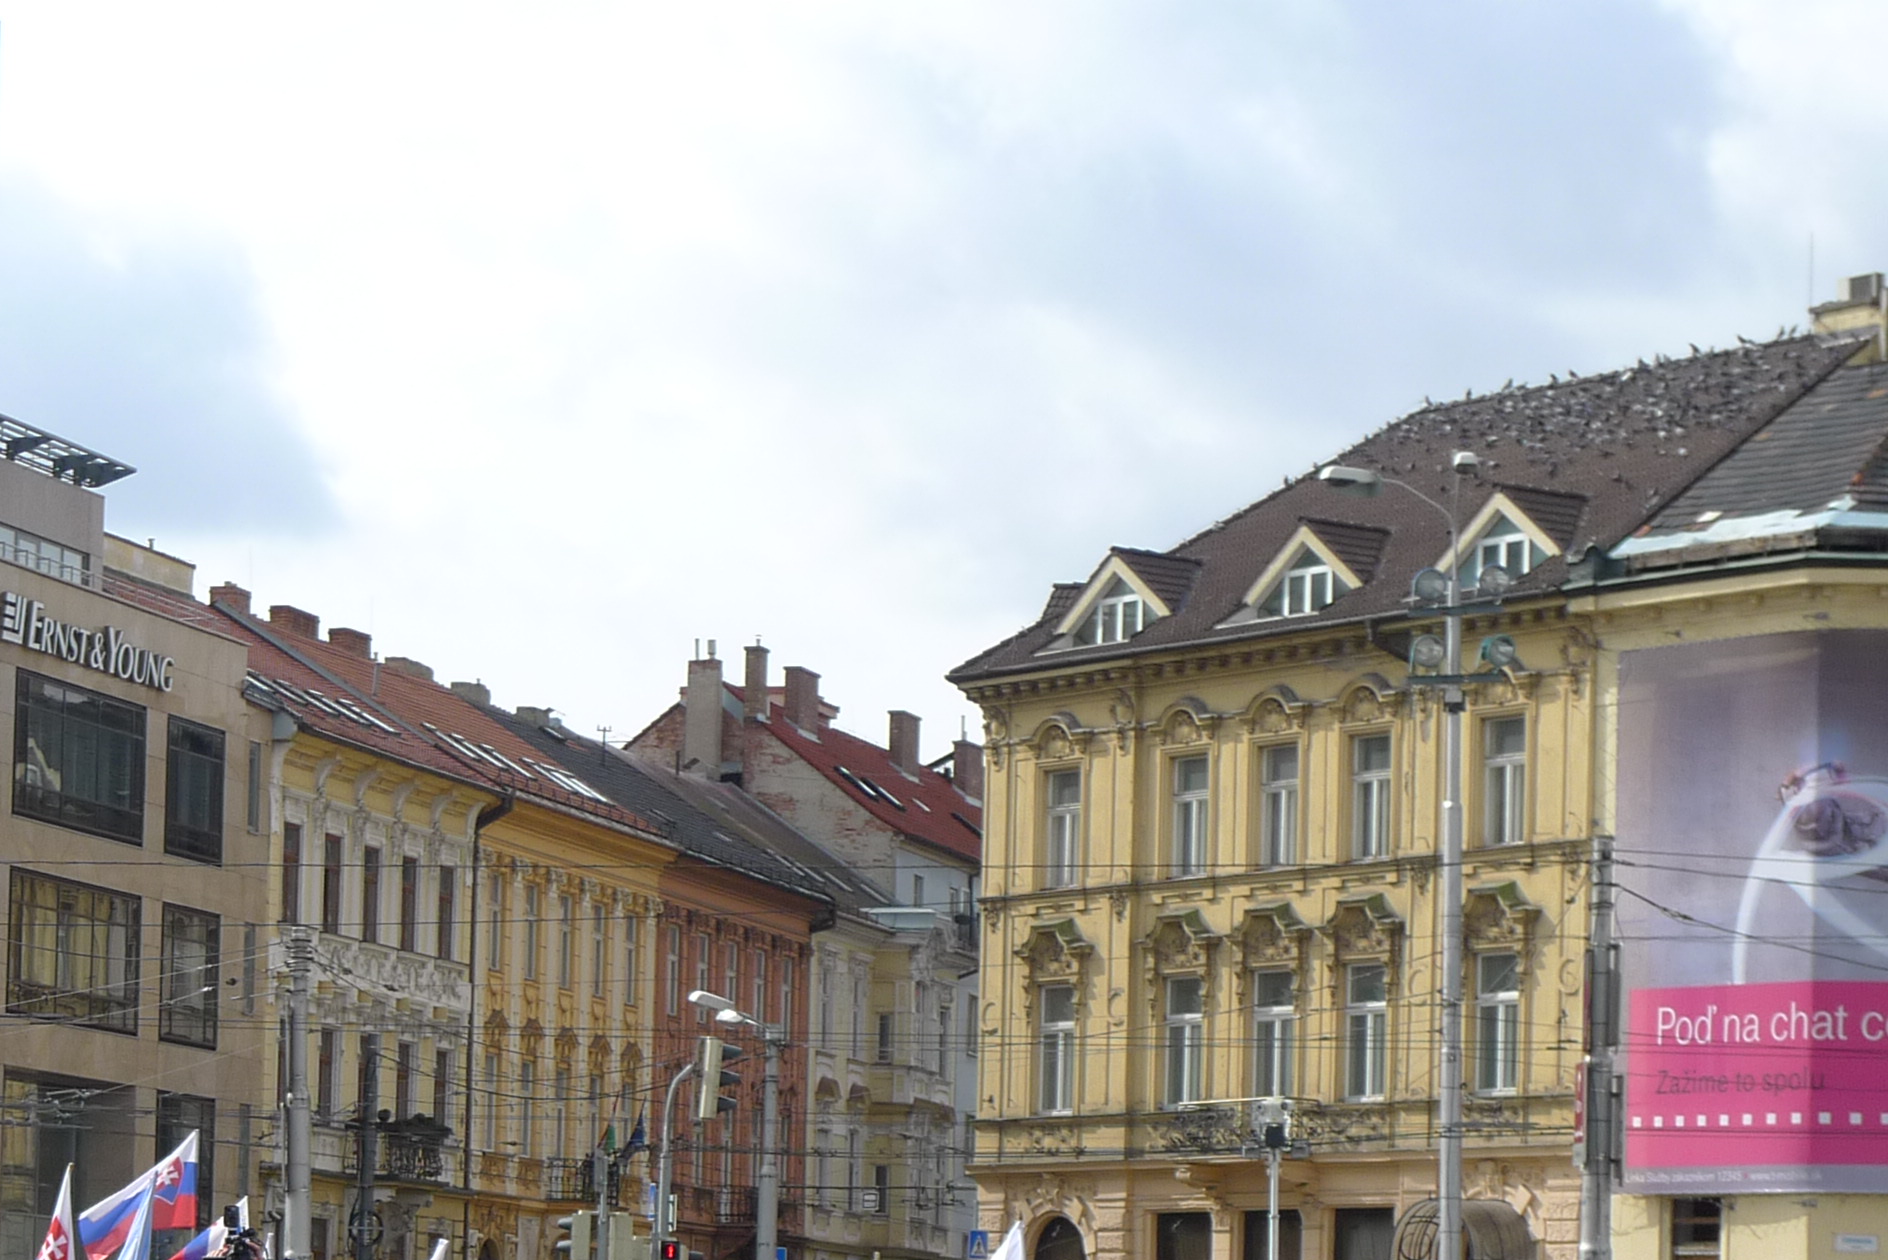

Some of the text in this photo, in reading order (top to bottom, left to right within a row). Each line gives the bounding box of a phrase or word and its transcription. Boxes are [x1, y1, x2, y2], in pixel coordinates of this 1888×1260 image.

[27, 599, 176, 692] ERNST & YOUNG
[1657, 1001, 1888, 1046] Poď na chat c
[1736, 1071, 1756, 1093] to
[1763, 1066, 1826, 1096] spolu
